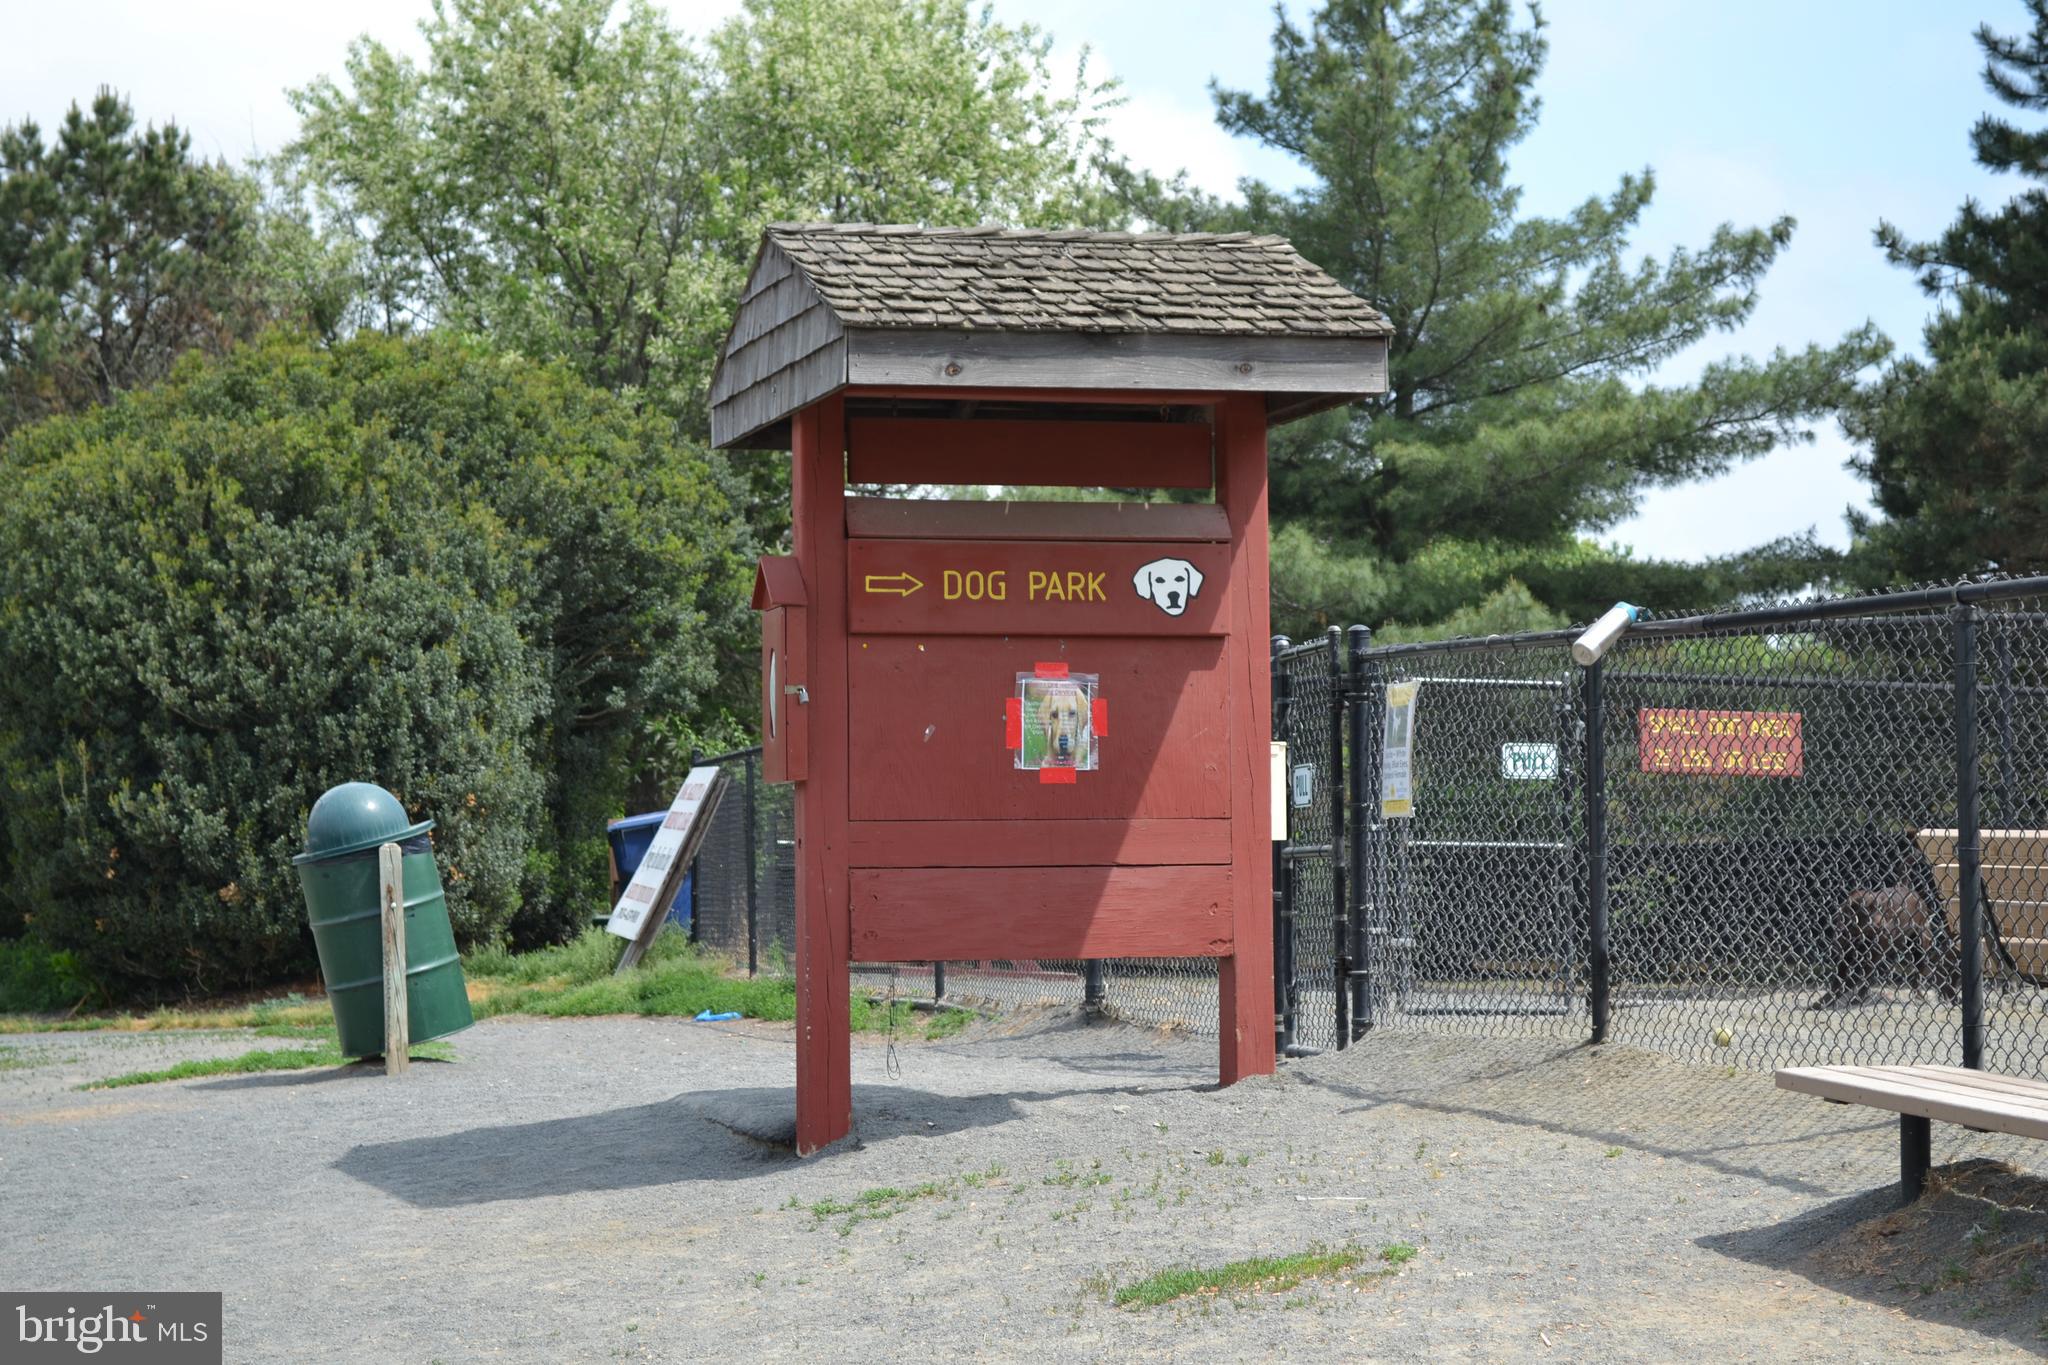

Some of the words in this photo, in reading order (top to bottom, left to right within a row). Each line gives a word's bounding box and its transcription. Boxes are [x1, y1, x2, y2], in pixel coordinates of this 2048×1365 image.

[943, 570, 1006, 600] DOG
[1029, 571, 1107, 602] PARK
[1648, 714, 1700, 736] SMALL
[1708, 717, 1742, 736] DOG
[1749, 718, 1792, 738] AREA
[1512, 751, 1550, 771] PULL
[1681, 748, 1713, 768] LBS
[1296, 774, 1308, 797] PULL
